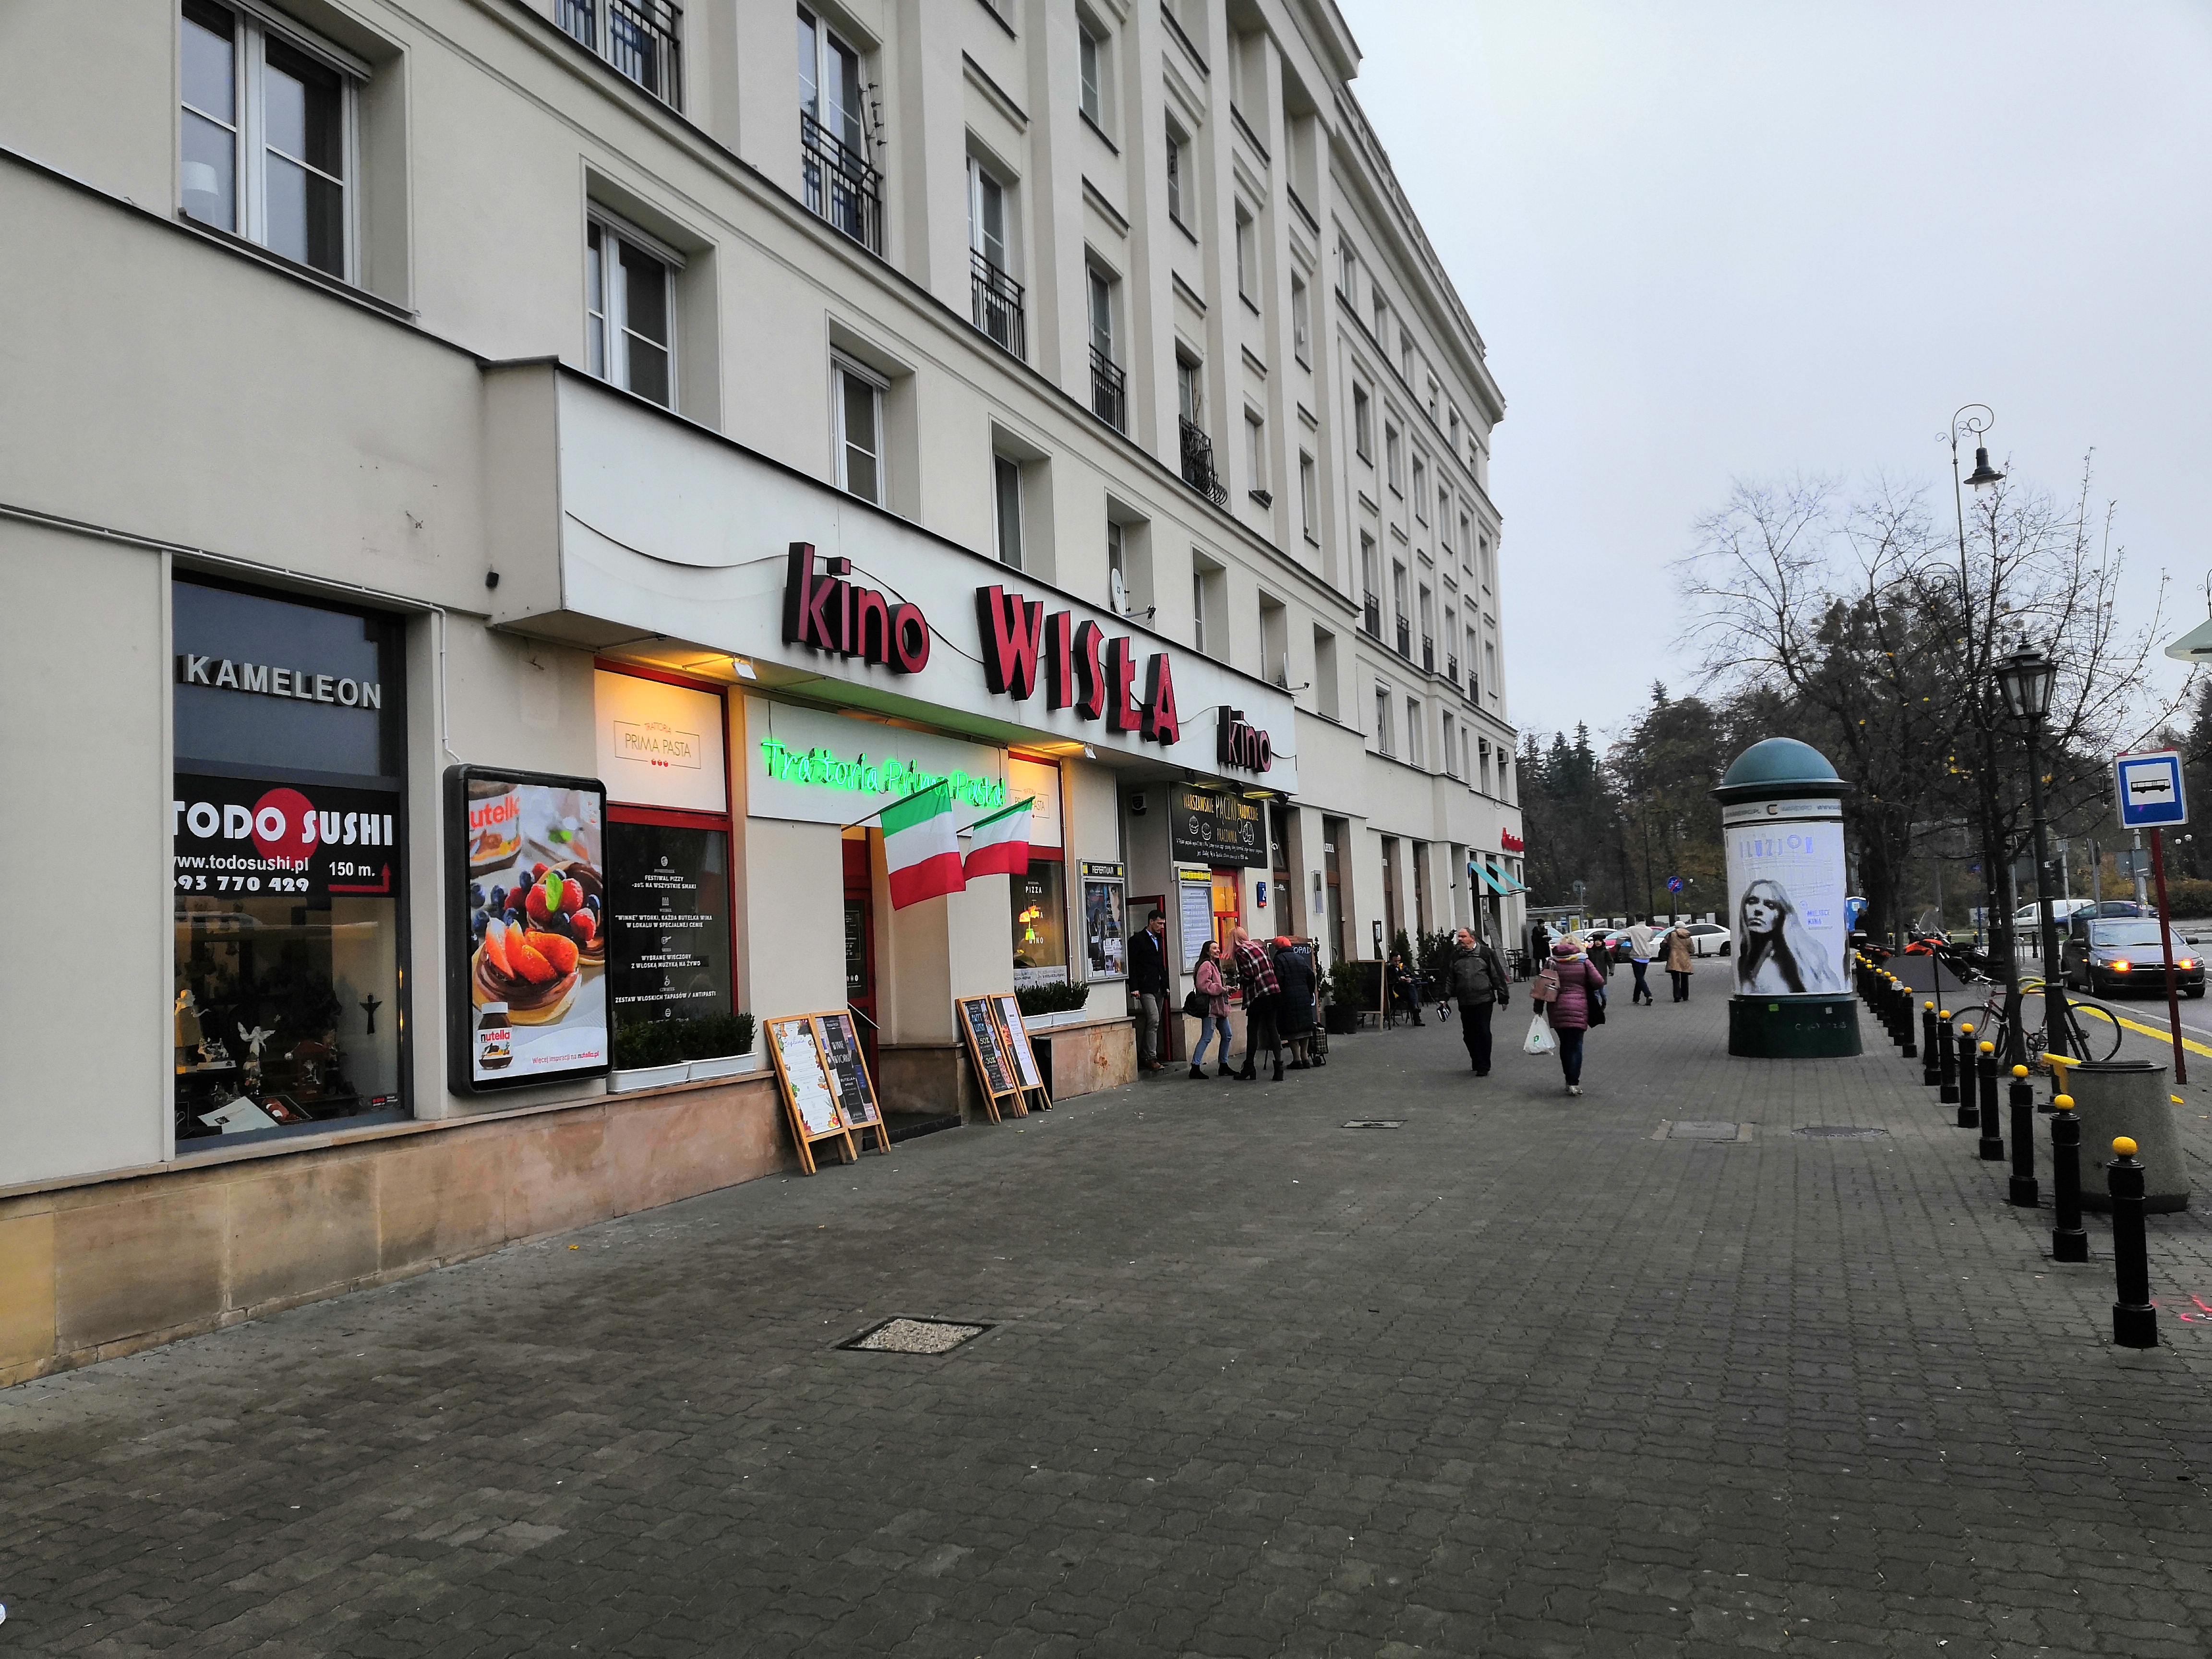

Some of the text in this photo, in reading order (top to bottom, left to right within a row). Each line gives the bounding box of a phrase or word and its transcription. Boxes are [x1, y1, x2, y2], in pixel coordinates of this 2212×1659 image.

[784, 542, 1180, 745] kino WISŁA
[187, 653, 381, 709] KAMELEON
[625, 733, 691, 758] PRIMA PASTA
[1218, 706, 1271, 772] kino
[173, 801, 393, 846] TODO SUSHI
[173, 875, 310, 892] 93 770 429
[328, 862, 354, 877] 150
[481, 1029, 510, 1042] nutella
